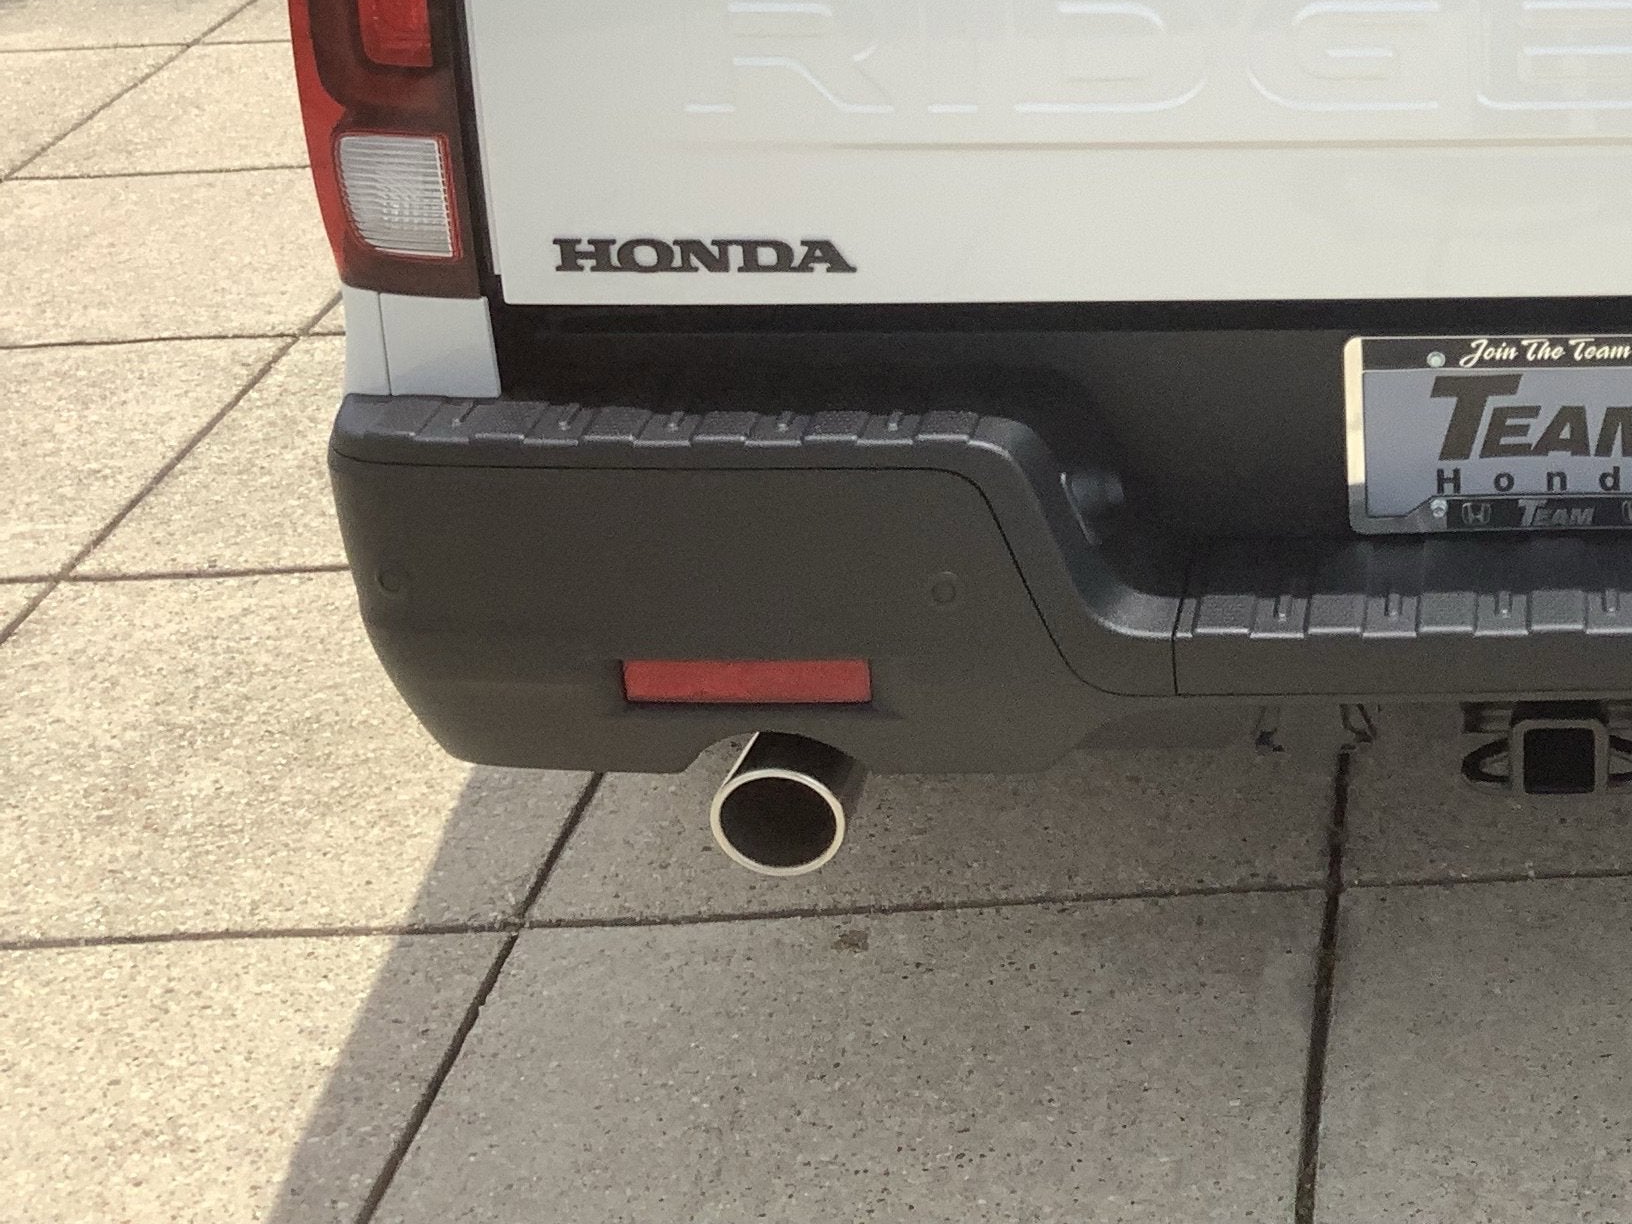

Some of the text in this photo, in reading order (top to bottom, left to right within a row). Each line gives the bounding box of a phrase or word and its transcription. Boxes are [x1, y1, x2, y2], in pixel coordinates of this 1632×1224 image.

[552, 238, 857, 273] HONDA
[1458, 338, 1519, 368] Join
[1520, 338, 1566, 362] The
[1517, 498, 1596, 527] TEAM
